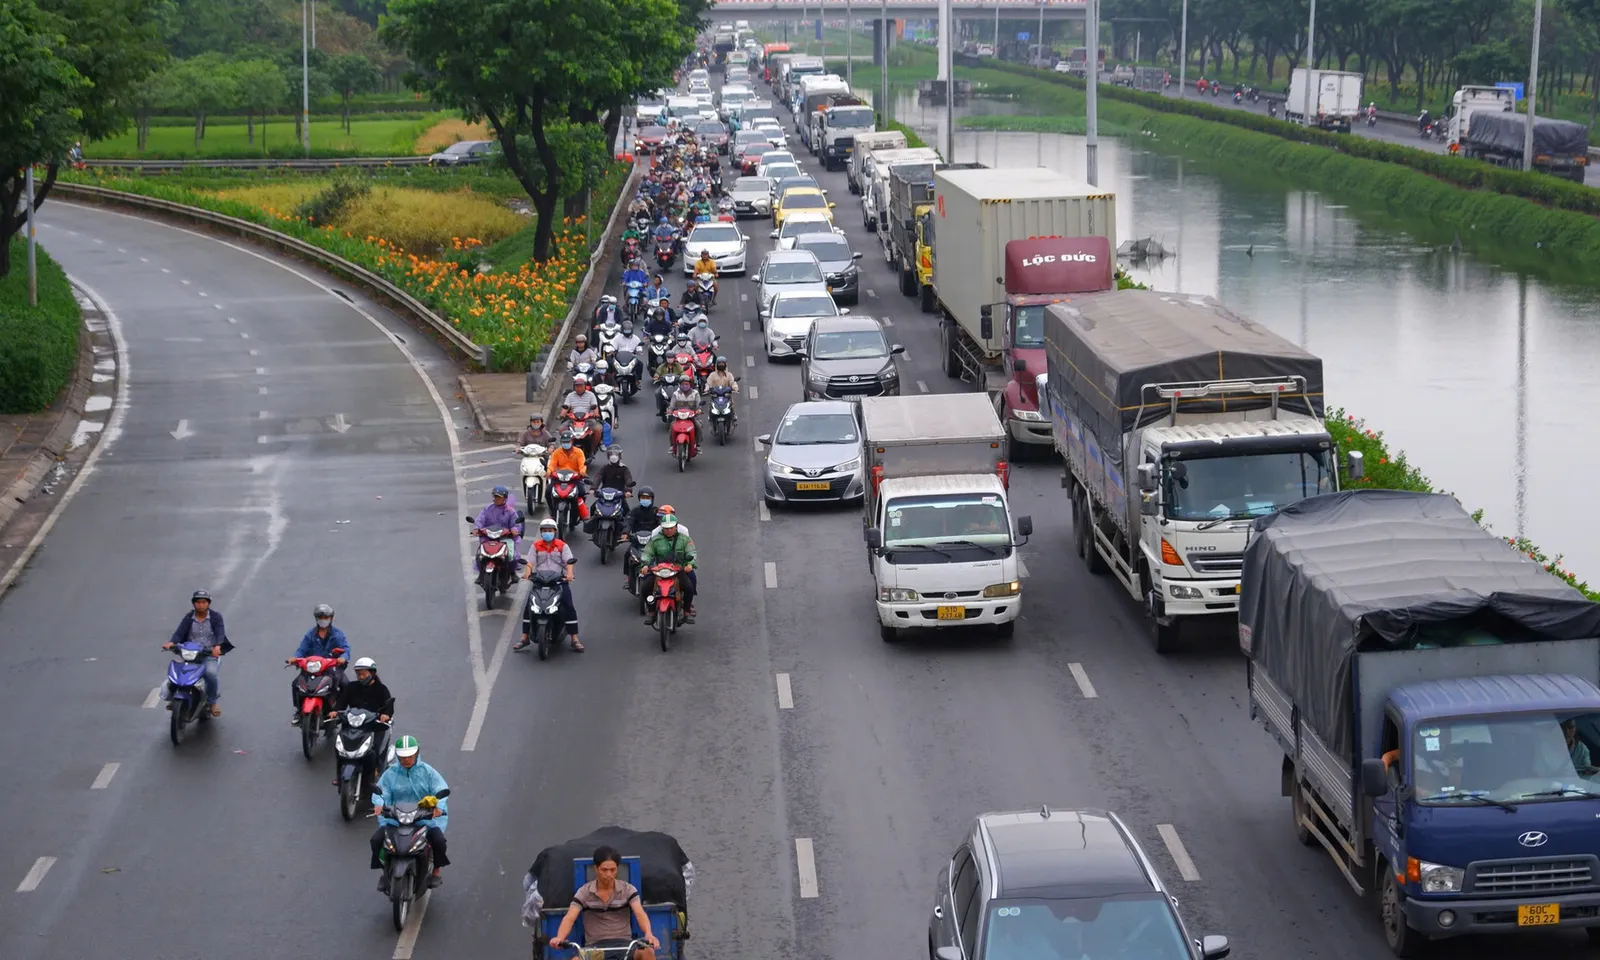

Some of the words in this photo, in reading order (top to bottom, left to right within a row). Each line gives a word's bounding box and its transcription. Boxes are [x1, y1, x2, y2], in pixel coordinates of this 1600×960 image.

[1022, 254, 1056, 267] LỘC
[1061, 250, 1097, 263] ĐỨC
[1529, 905, 1548, 915] 60C
[1523, 914, 1555, 925] 283.22
